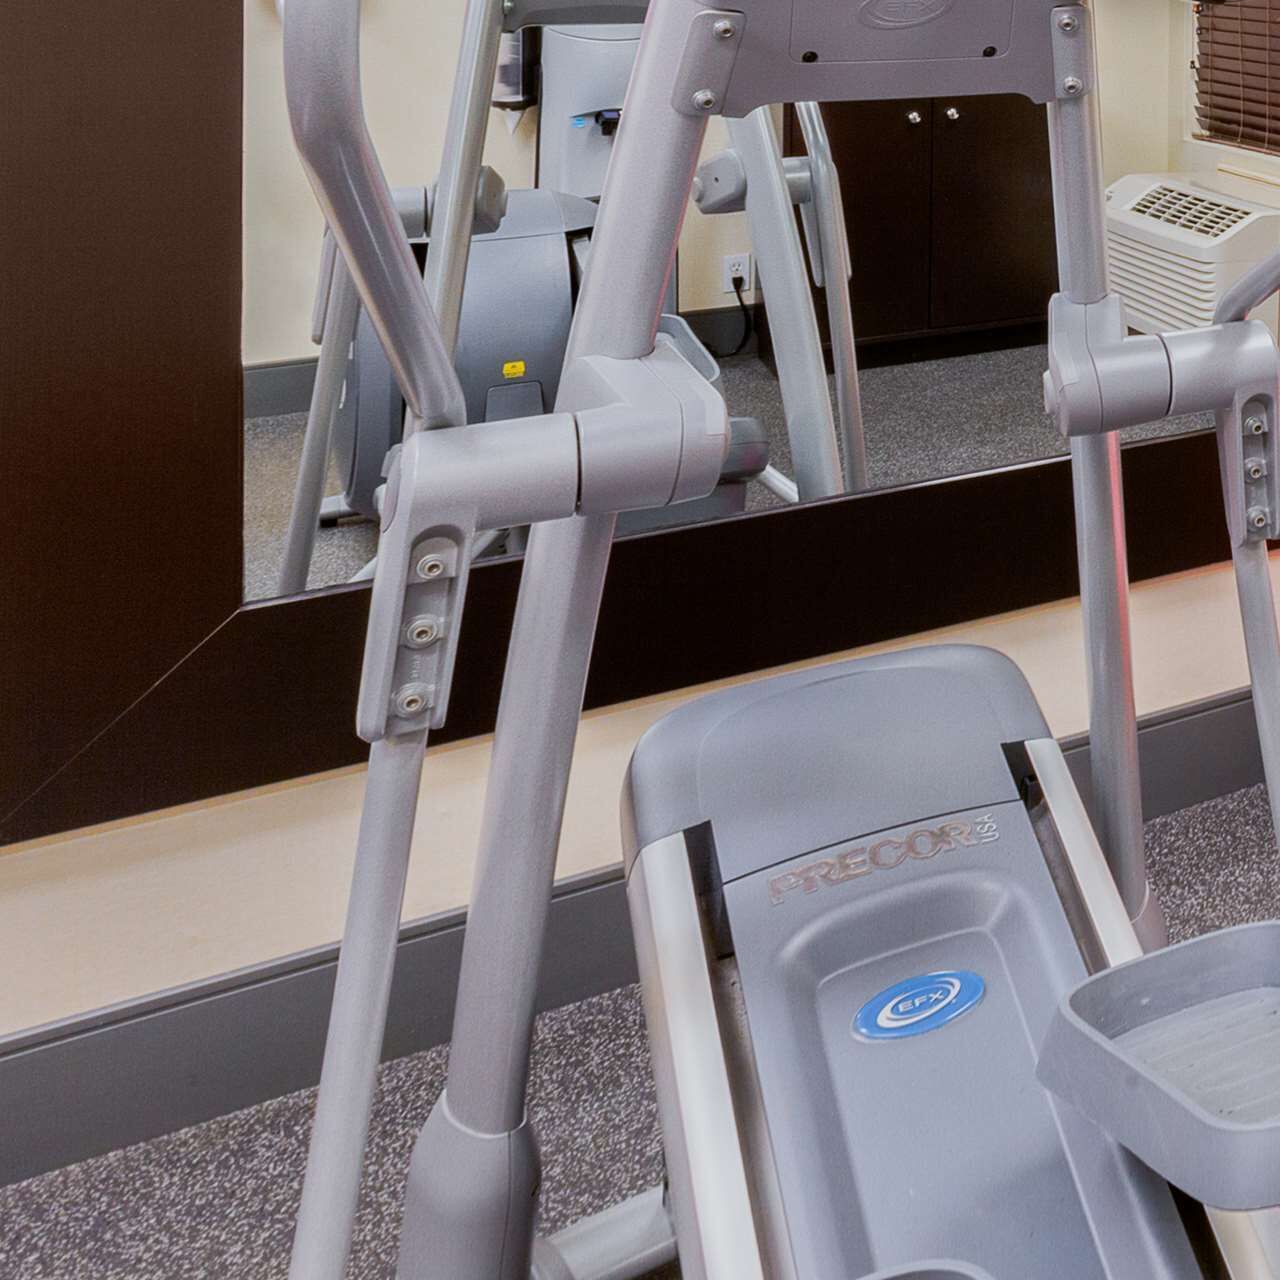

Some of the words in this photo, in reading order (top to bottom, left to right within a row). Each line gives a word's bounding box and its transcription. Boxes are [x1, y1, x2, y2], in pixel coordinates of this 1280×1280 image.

[976, 812, 1001, 844] USA
[768, 822, 979, 907] PRECOR
[898, 990, 945, 1013] EFX
